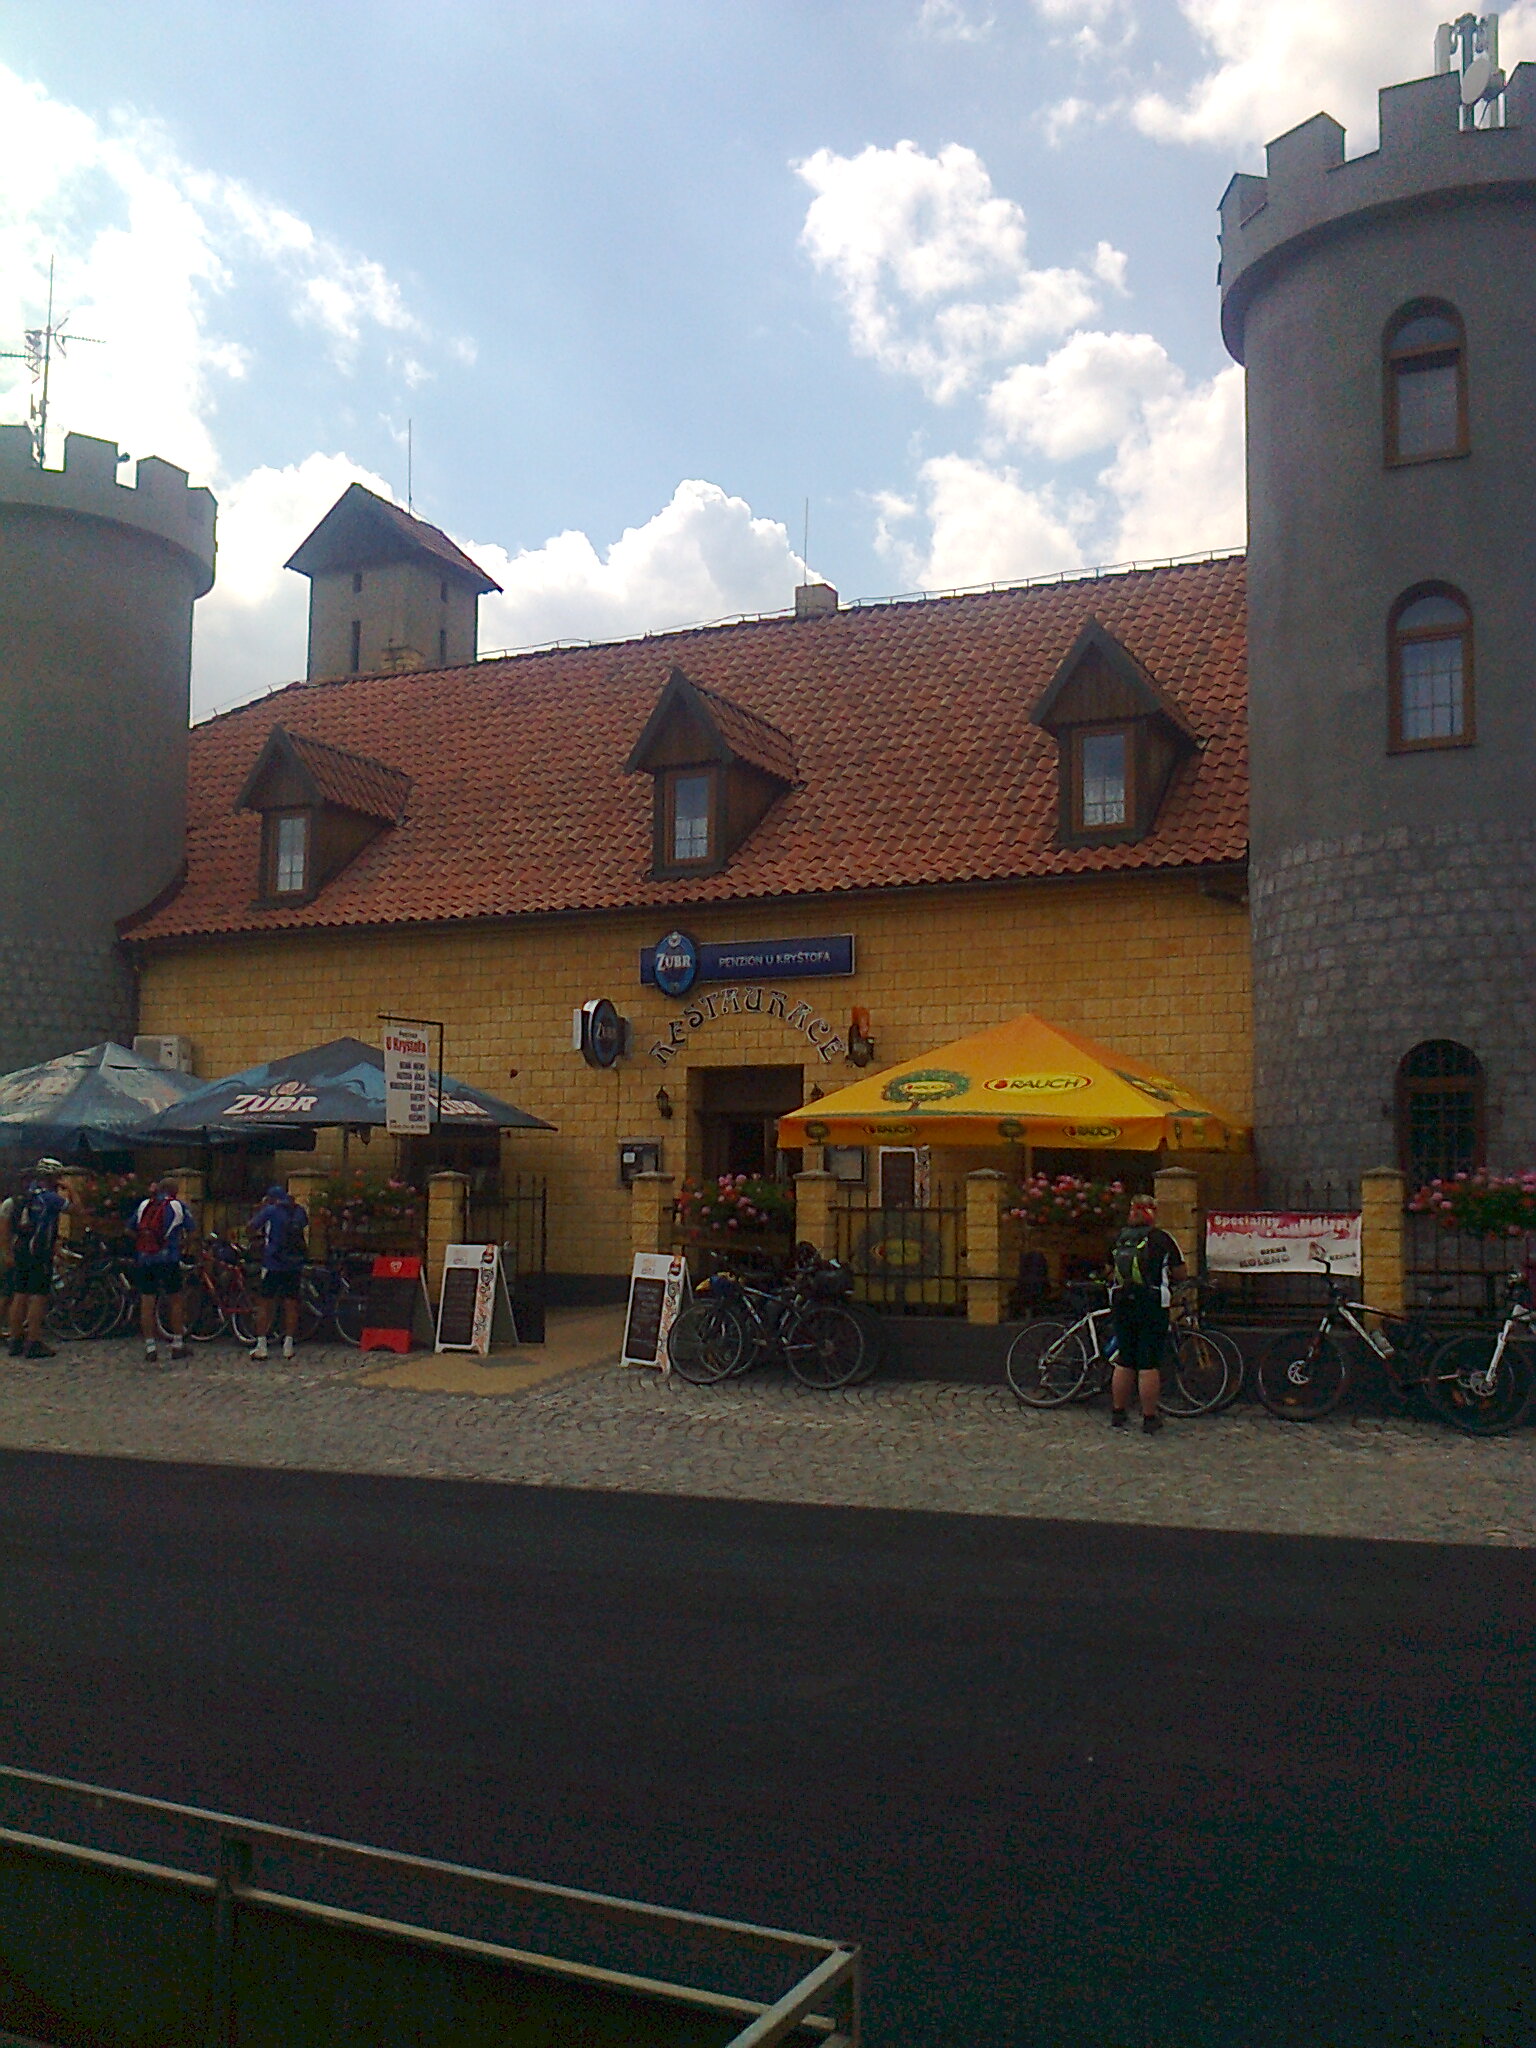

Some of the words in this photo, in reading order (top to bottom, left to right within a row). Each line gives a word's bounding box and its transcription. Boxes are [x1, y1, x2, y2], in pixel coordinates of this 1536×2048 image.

[656, 952, 692, 971] ZUBR
[719, 956, 764, 968] PENZION
[766, 955, 774, 966] U
[649, 985, 849, 1064] RESTAURACE
[1009, 1077, 1080, 1090] RAUCH
[223, 1094, 319, 1115] ZUBR
[1214, 1215, 1280, 1229] Speciality
